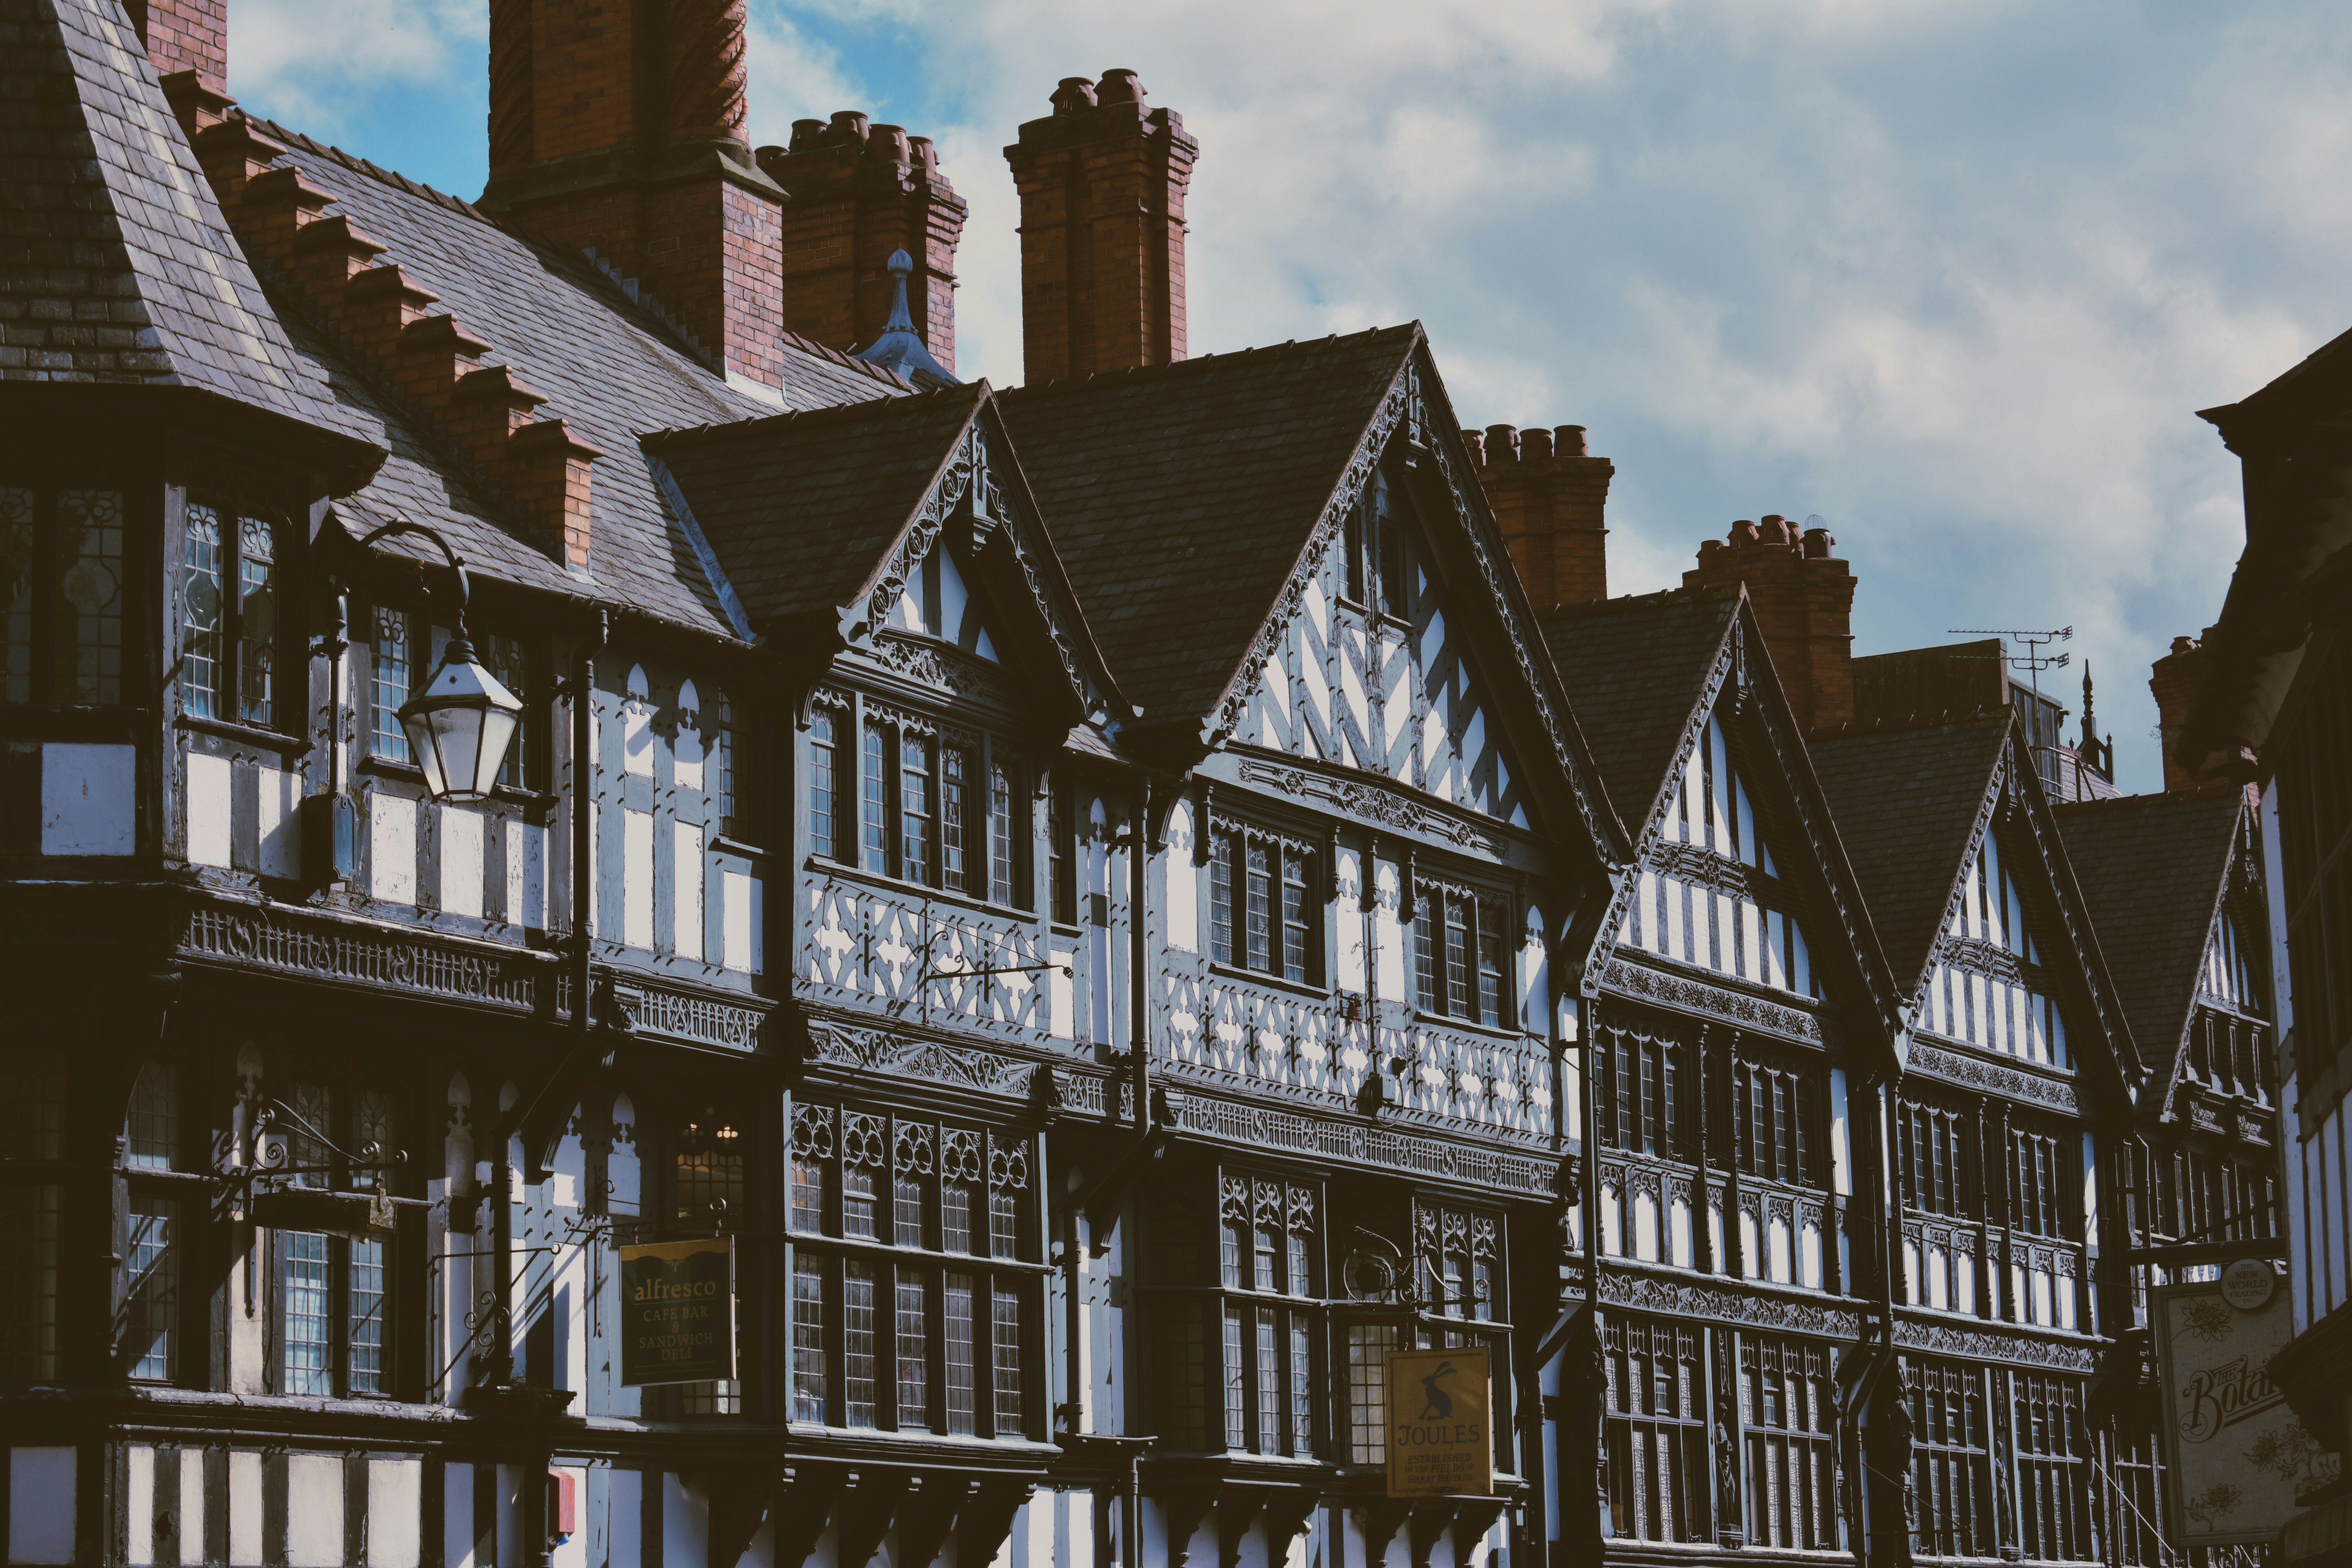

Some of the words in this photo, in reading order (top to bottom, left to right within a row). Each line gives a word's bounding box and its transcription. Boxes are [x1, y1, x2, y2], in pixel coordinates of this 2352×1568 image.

[2235, 1270, 2259, 1279] NEW
[635, 1278, 716, 1301] alfresco
[2228, 1279, 2268, 1289] WORLD
[2229, 1289, 2267, 1298] TRADING
[644, 1308, 677, 1321] CAFE
[682, 1306, 708, 1318] BAR
[672, 1321, 679, 1332] &
[639, 1333, 713, 1348] SANDWICH
[661, 1347, 691, 1361] DELI
[2217, 1367, 2237, 1386] THE
[2179, 1354, 2276, 1443] Bota
[1398, 1425, 1480, 1446] JOULES
[1408, 1453, 1472, 1464] ESTABLISHED
[1431, 1463, 1465, 1473] FIELDS
[1408, 1475, 1436, 1483] GREAT
[1438, 1474, 1472, 1483] BRITAIN
